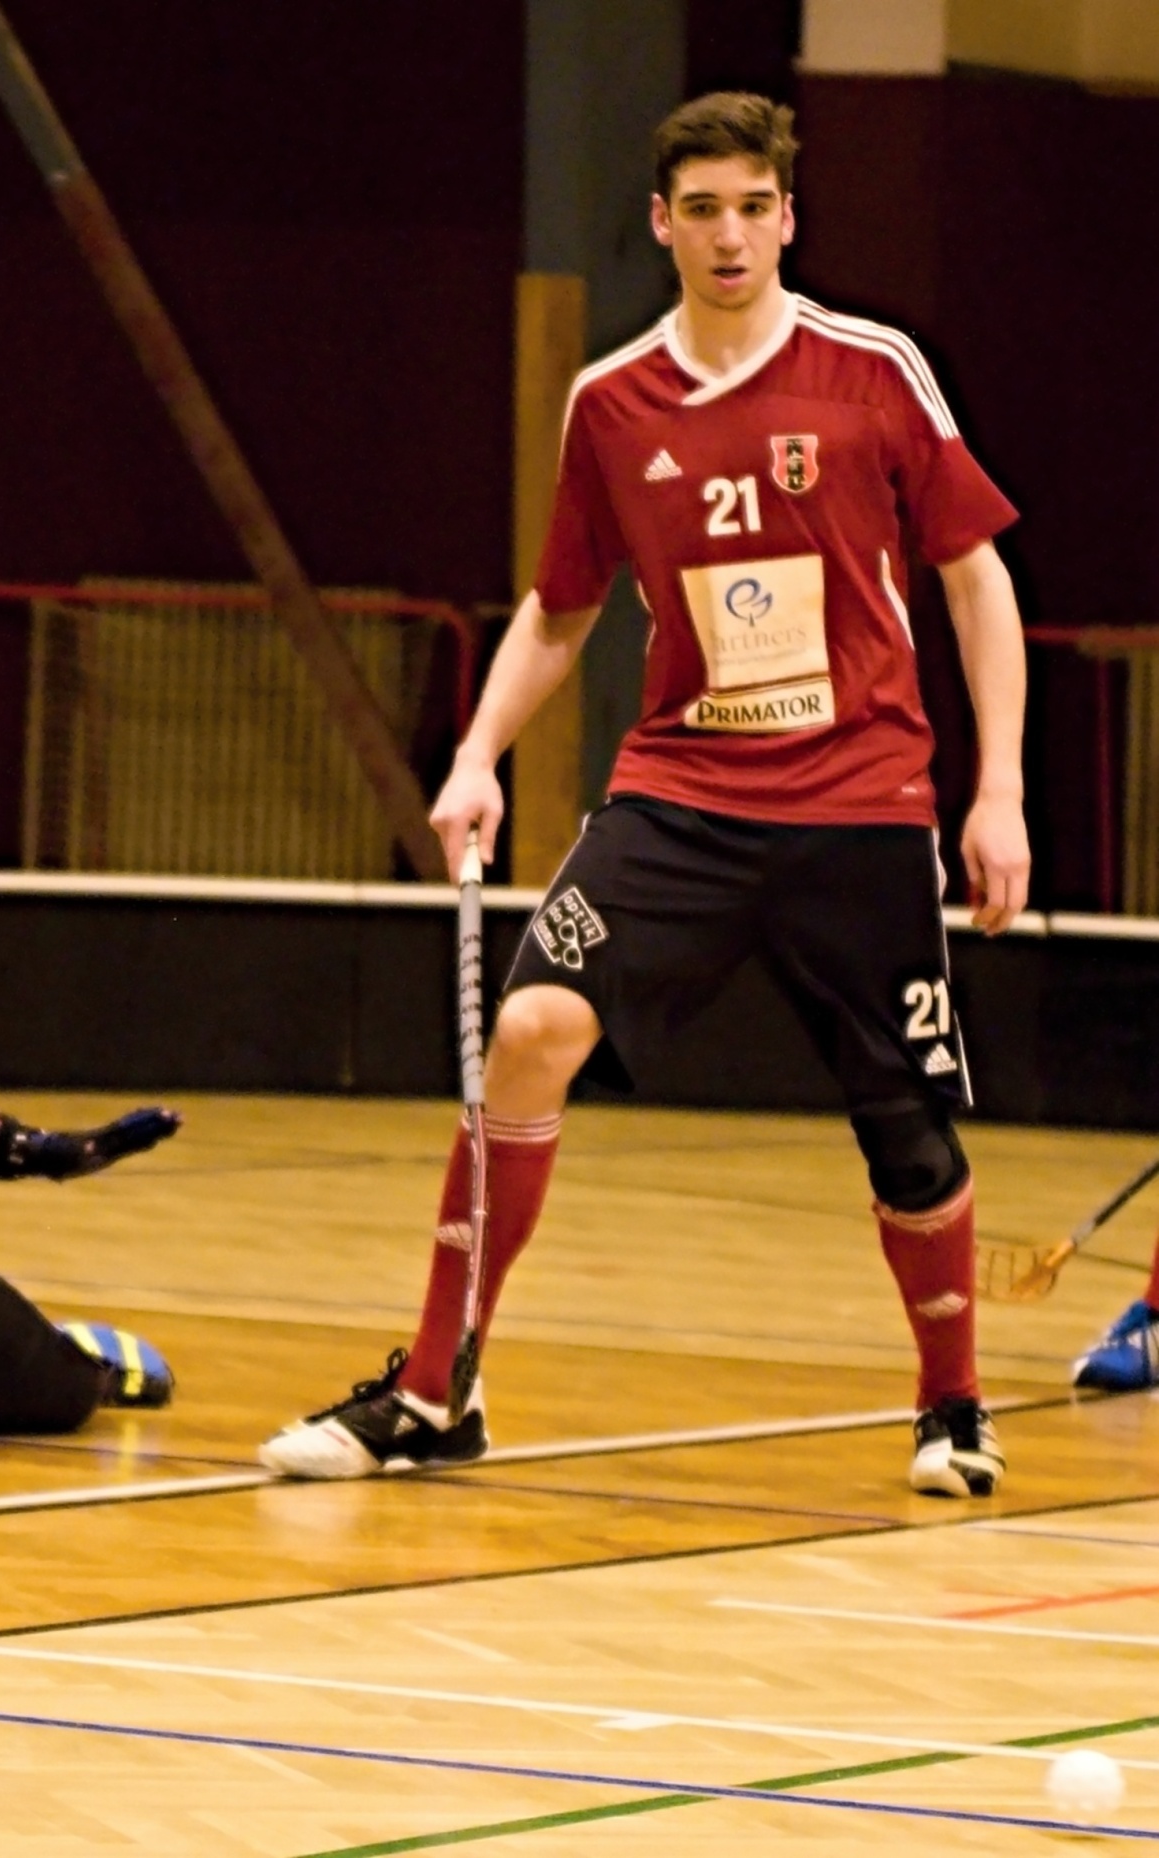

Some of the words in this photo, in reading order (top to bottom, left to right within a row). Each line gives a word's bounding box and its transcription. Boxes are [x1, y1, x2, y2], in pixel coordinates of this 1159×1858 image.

[702, 474, 761, 536] 21
[697, 694, 823, 724] PRIMATOR
[905, 979, 950, 1039] 21
